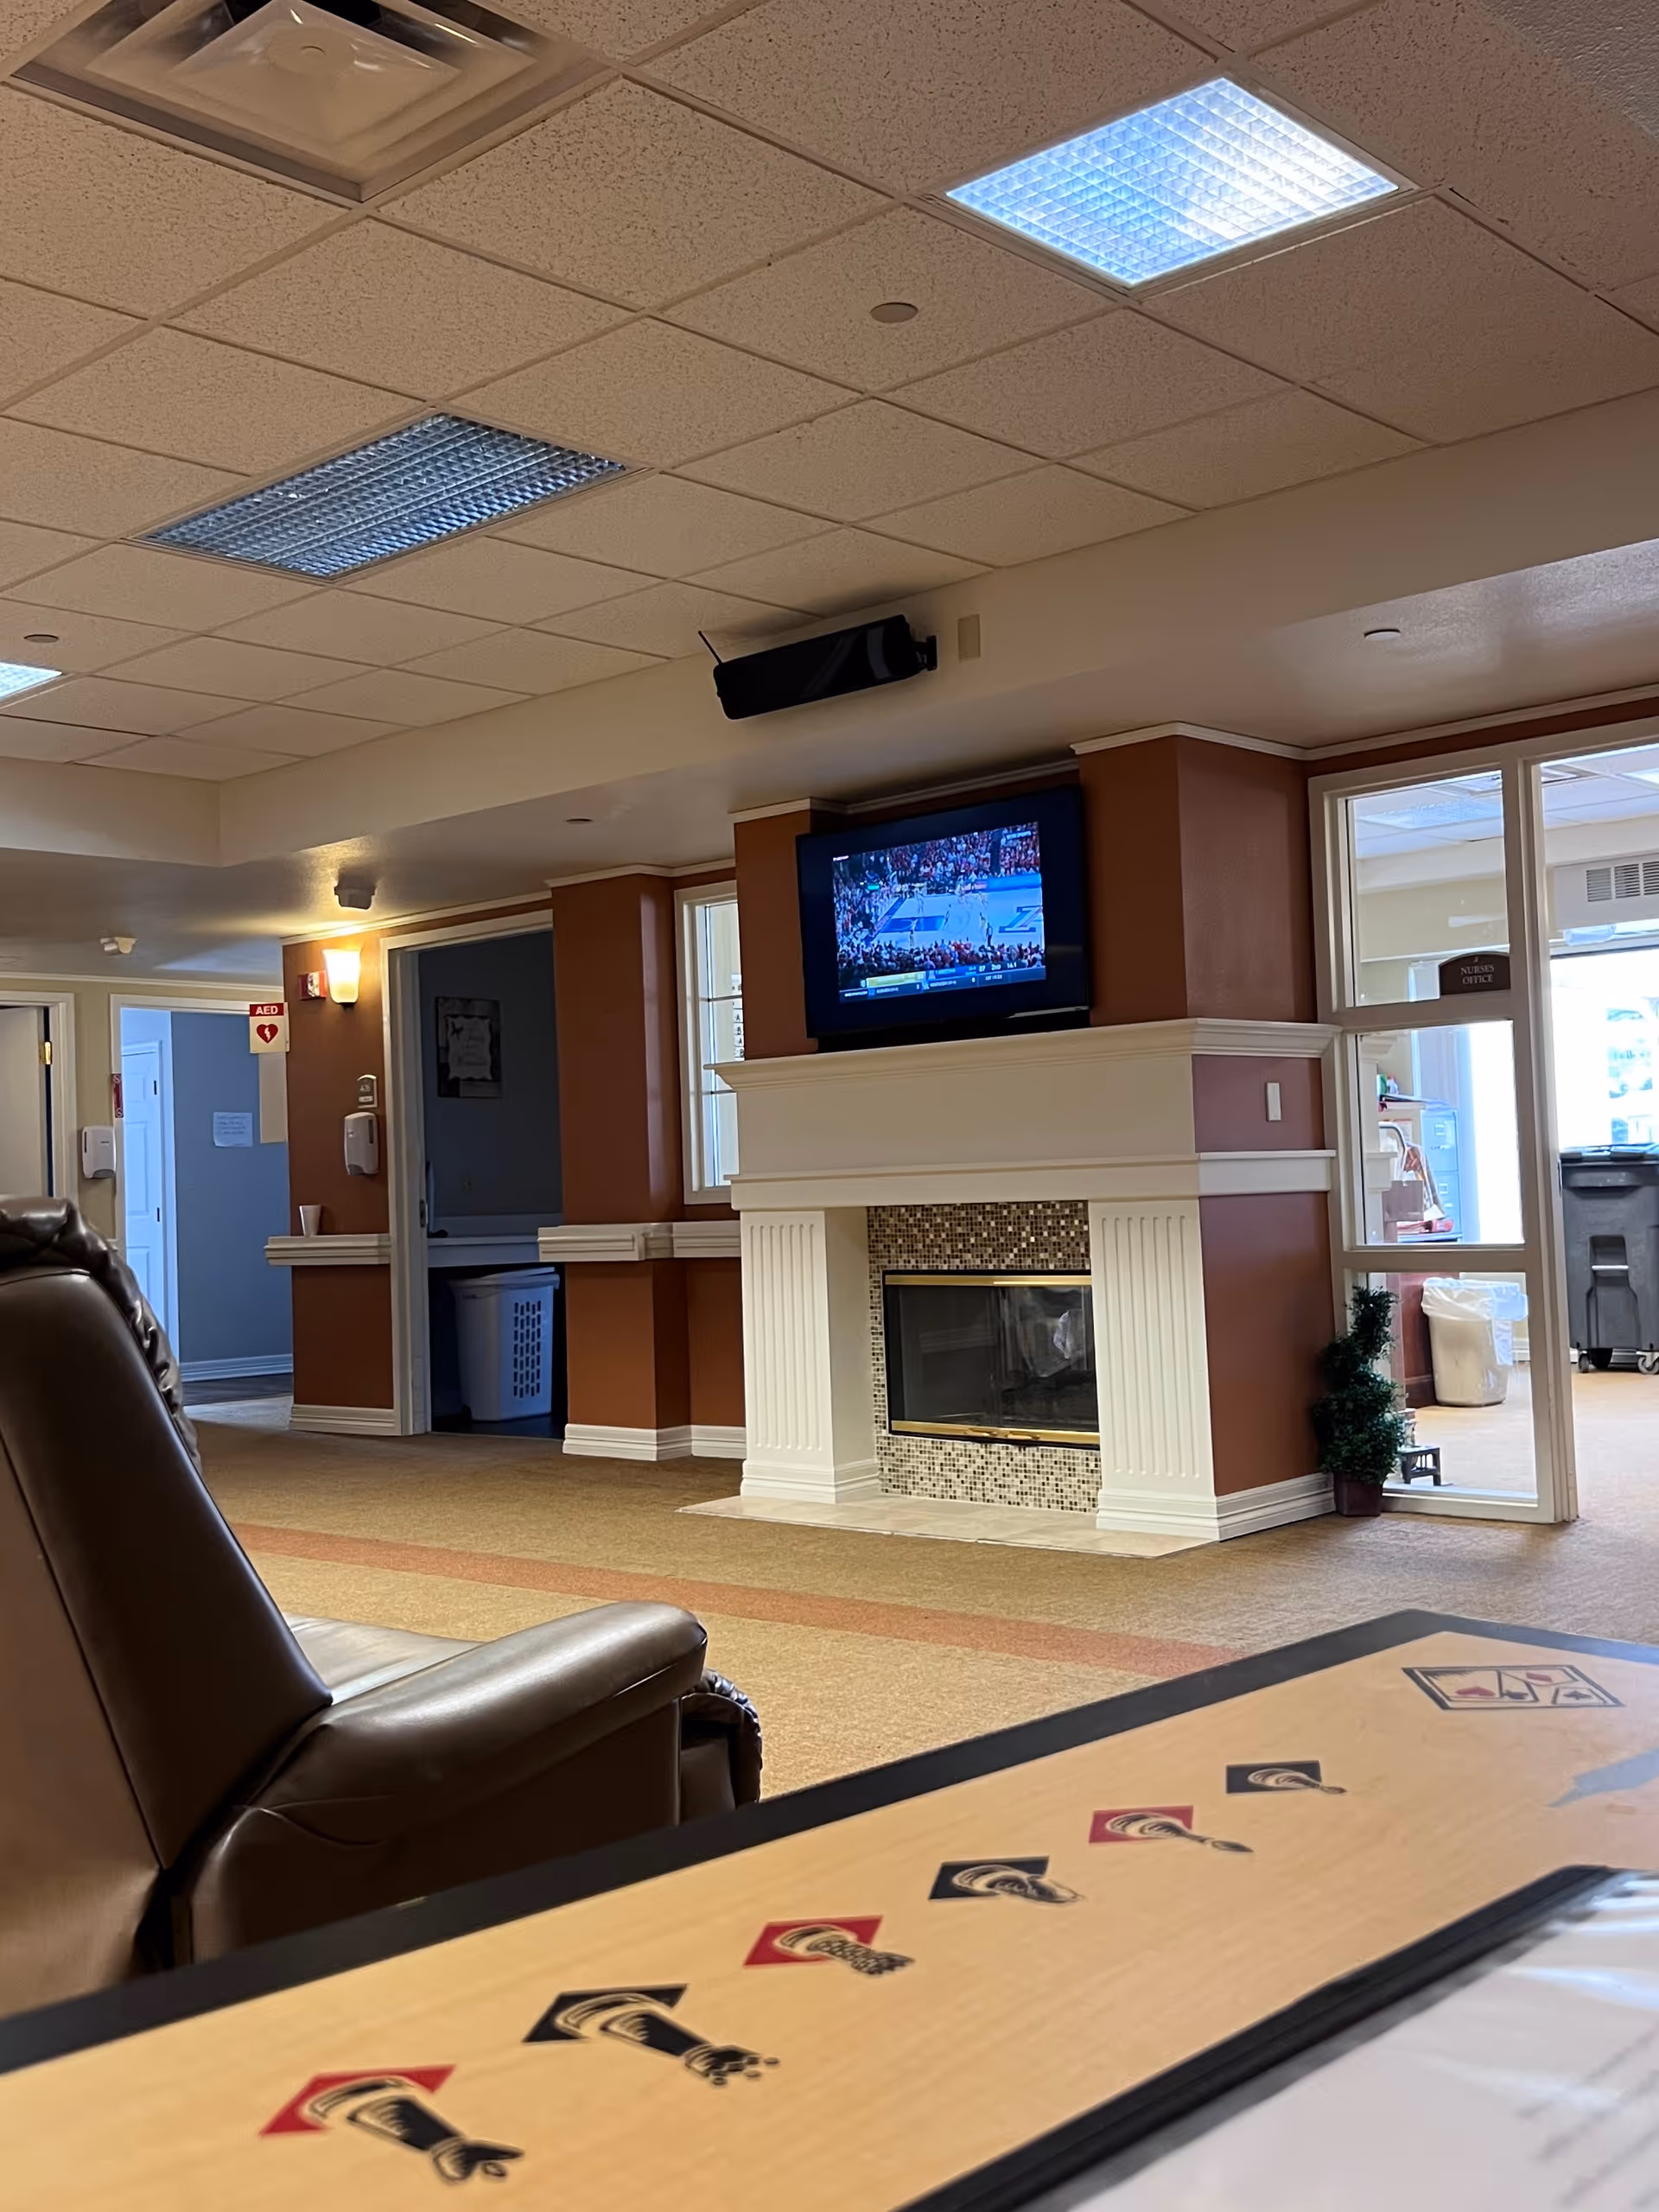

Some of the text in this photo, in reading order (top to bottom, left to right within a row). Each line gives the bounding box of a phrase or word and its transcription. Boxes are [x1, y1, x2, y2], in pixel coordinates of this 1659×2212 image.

[1460, 965, 1495, 975] NURSES
[1462, 975, 1493, 984] OFFICE
[256, 1005, 278, 1015] AED
